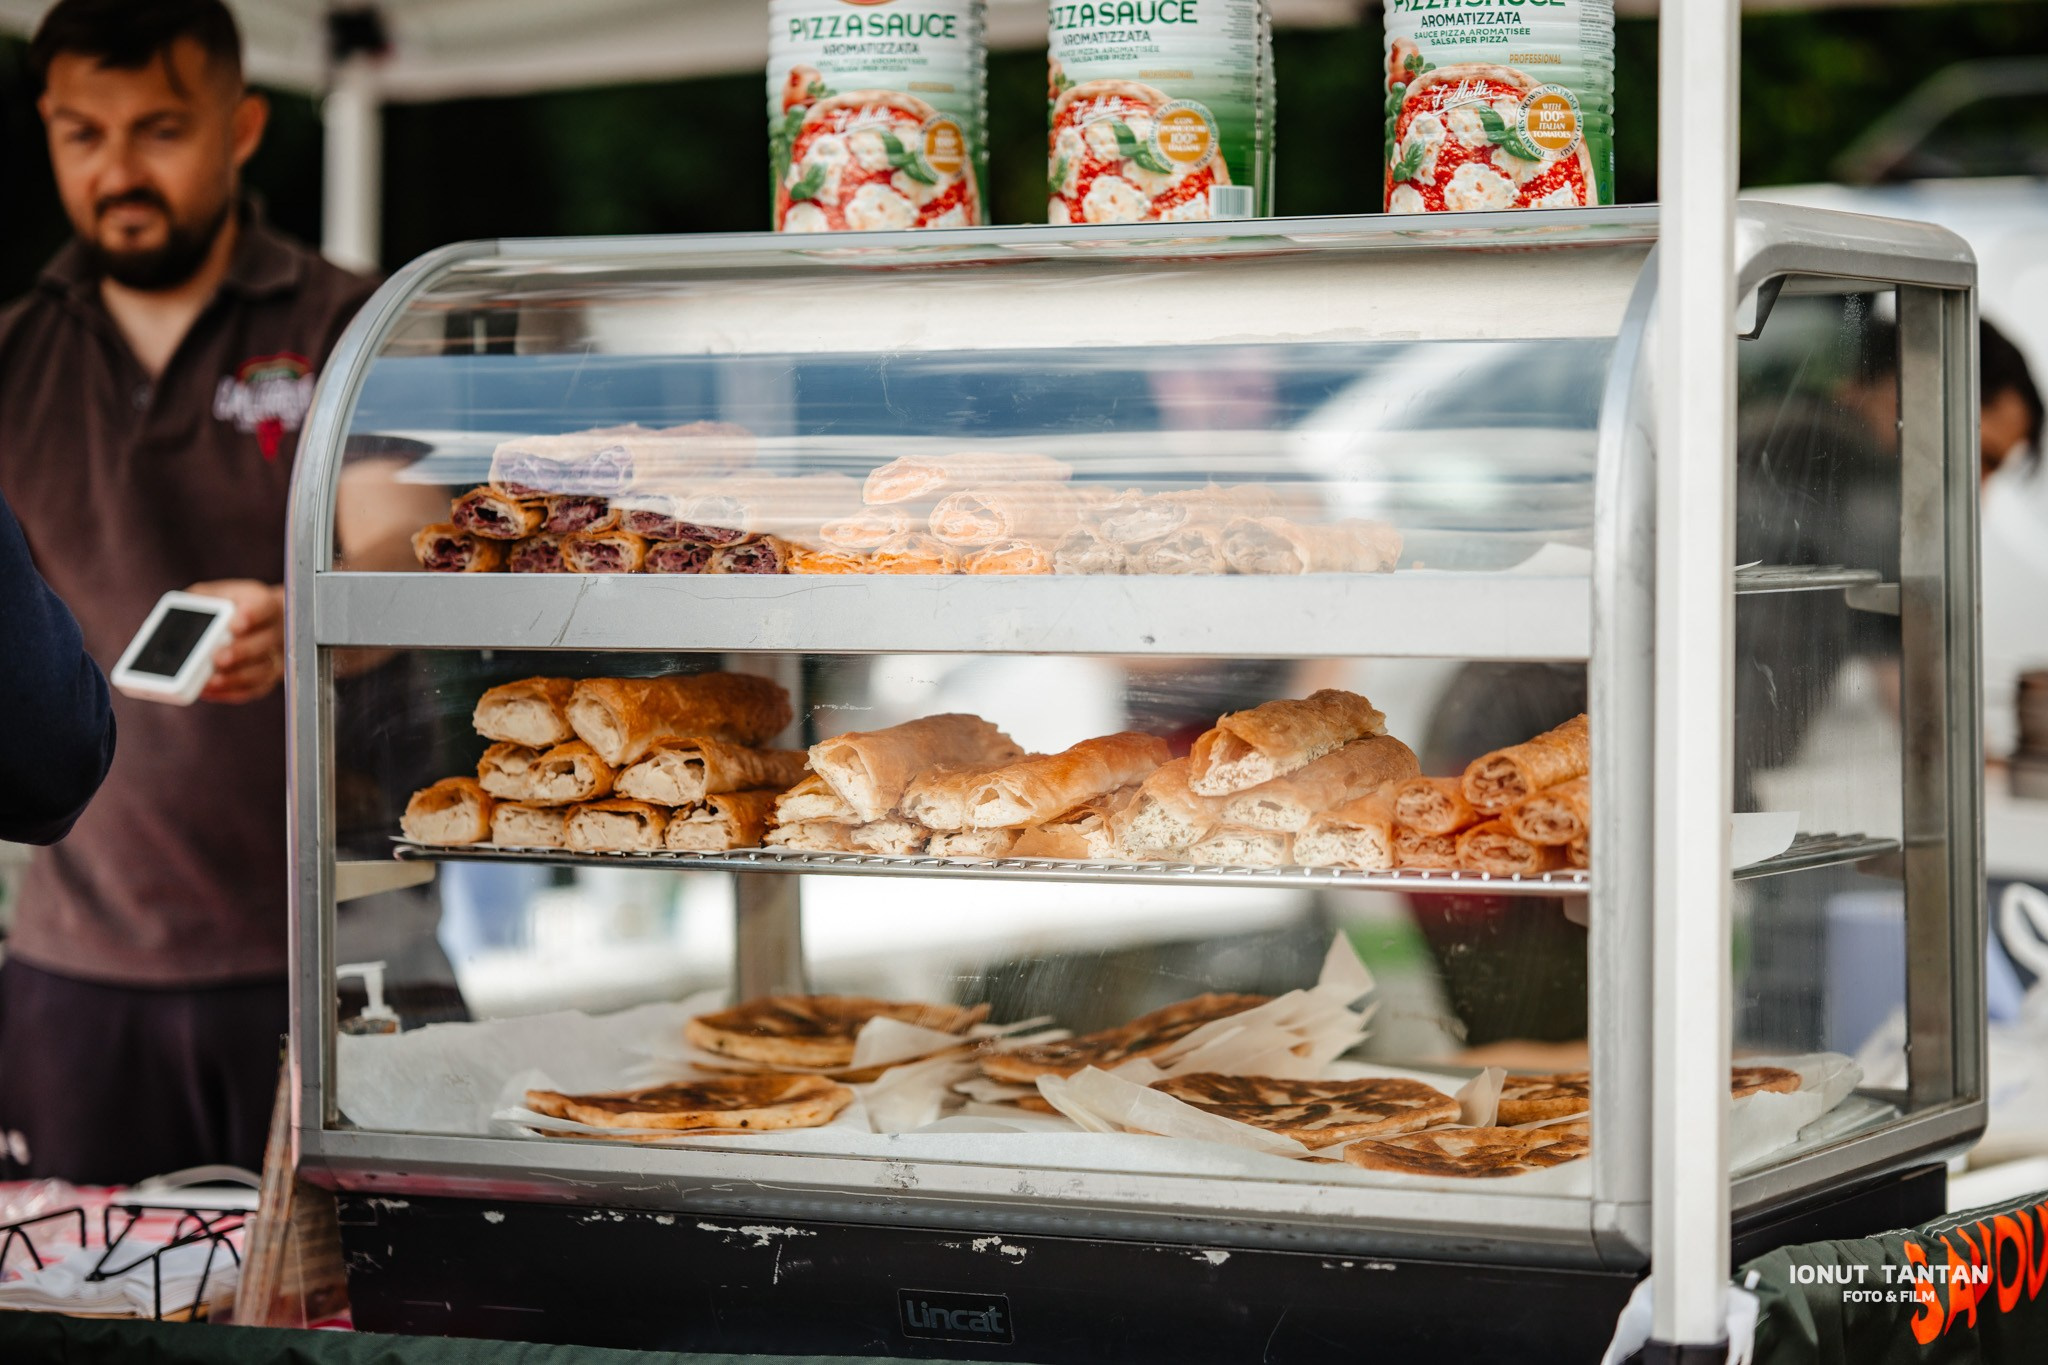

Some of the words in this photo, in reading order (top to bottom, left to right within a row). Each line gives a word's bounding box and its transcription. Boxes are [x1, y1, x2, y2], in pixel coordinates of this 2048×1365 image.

[1420, 12, 1522, 28] AROMATIZZATA
[1063, 30, 1152, 45] AROMATIZZATA
[1414, 30, 1438, 39] SAUCE
[1440, 29, 1466, 37] PIZZA
[1509, 54, 1561, 64] PROFESSIONAL
[1539, 122, 1565, 130] ITALIAN
[1532, 130, 1571, 138] TOMATOES
[1904, 1200, 2048, 1345] SAVOU
[906, 1300, 1004, 1333] Lincat
